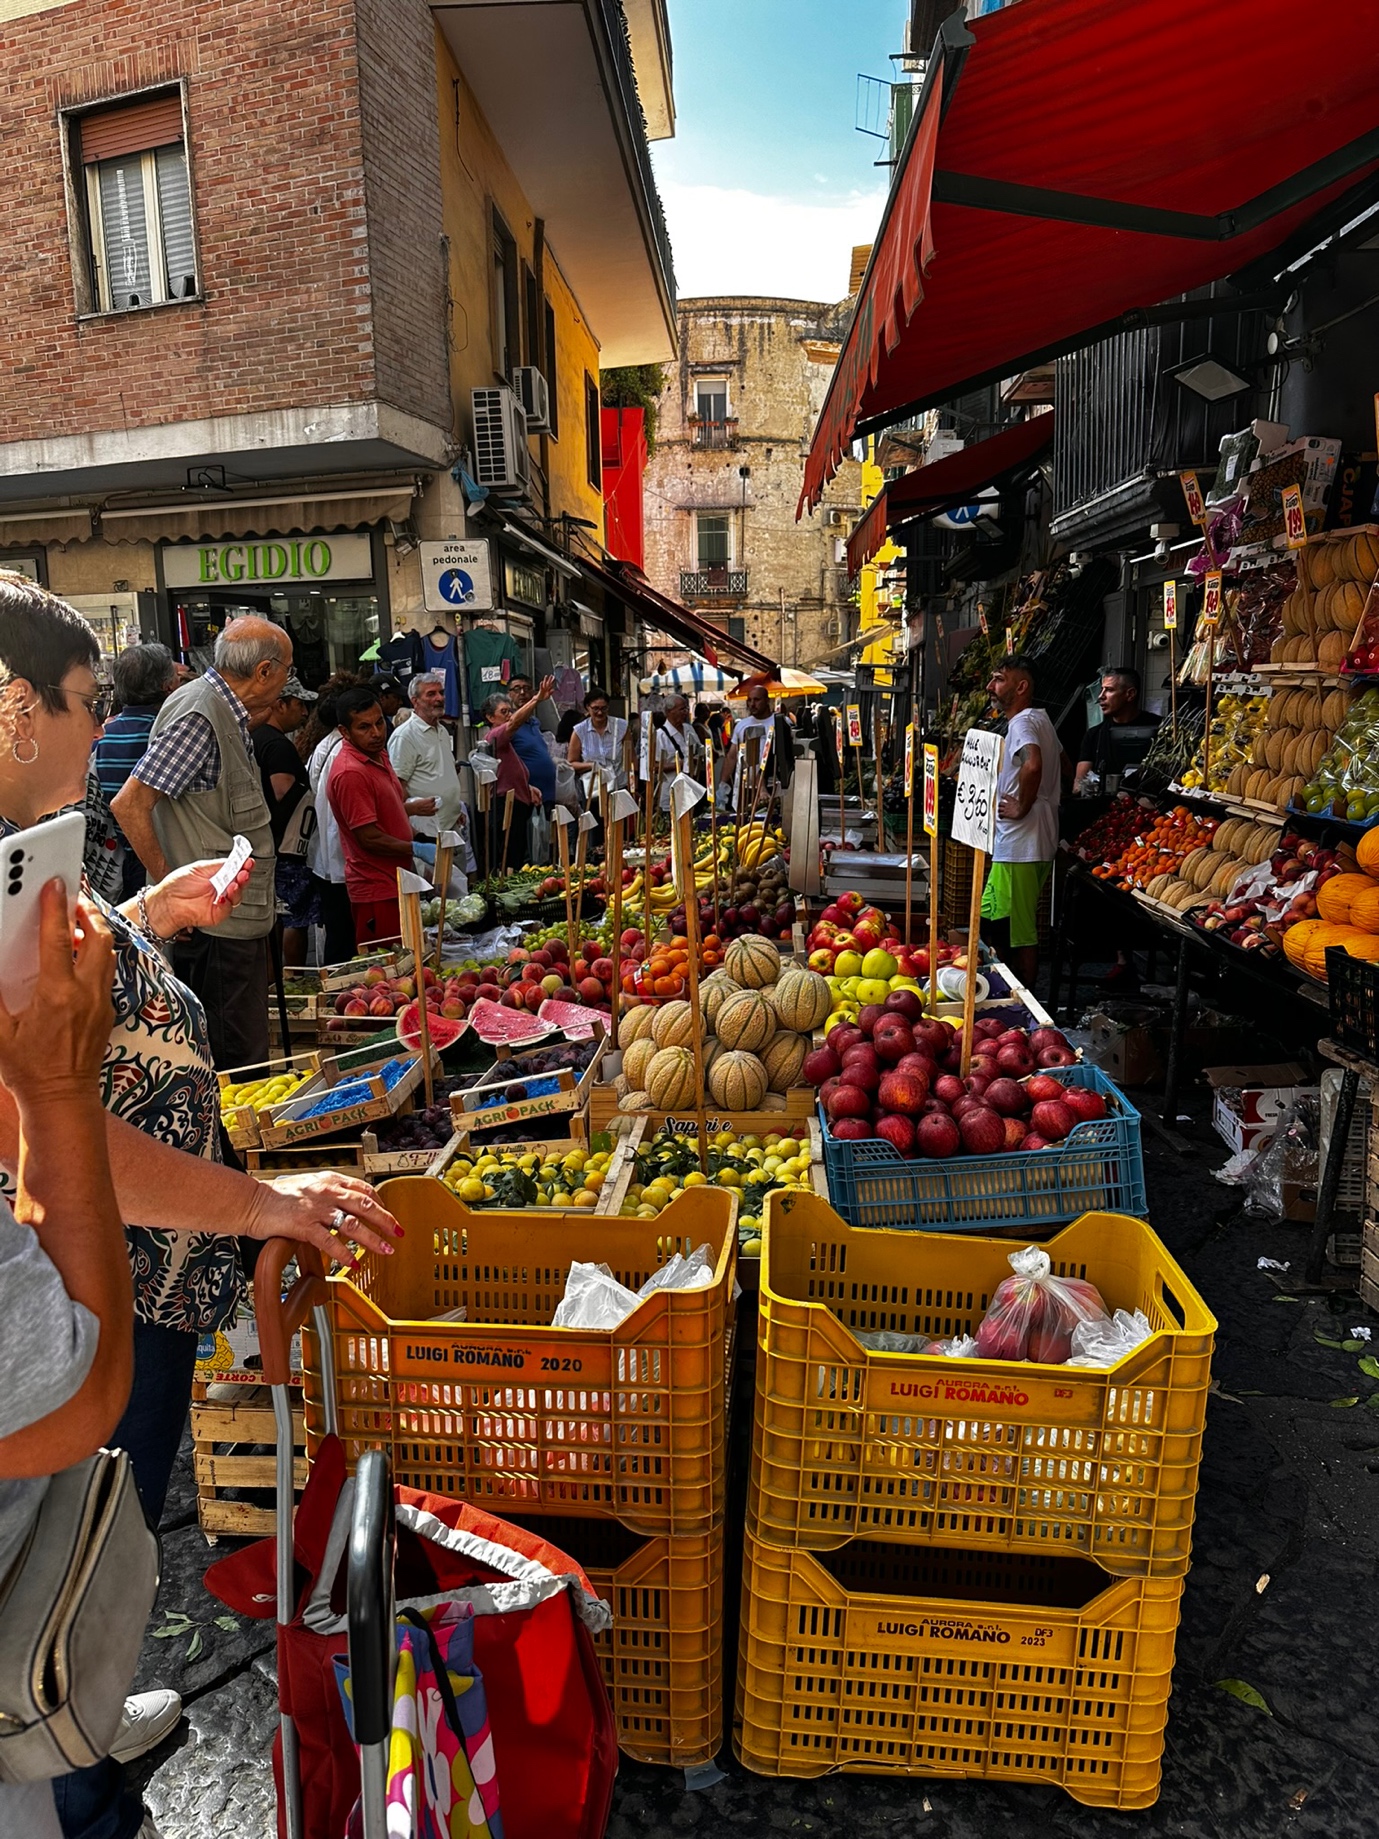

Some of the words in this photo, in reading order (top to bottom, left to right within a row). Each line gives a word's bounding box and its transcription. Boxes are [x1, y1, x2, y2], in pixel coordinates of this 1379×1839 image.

[198, 539, 331, 582] EGIDIO
[432, 555, 478, 565] pedonale
[658, 1115, 719, 1136] Sapri
[406, 1345, 448, 1362] LUIGI
[453, 1350, 525, 1368] ROMANO
[540, 1357, 582, 1372] 2020
[215, 1373, 256, 1382] CORTE
[936, 1379, 990, 1389] AURORA
[890, 1382, 939, 1398] LUIGI
[945, 1386, 1029, 1406] ROMANO
[921, 1618, 973, 1629] AURORA
[877, 1621, 924, 1637] LUIGI
[929, 1626, 1011, 1643] ROMANO
[1034, 1627, 1054, 1638] DF3
[1020, 1636, 1046, 1647] 2023
